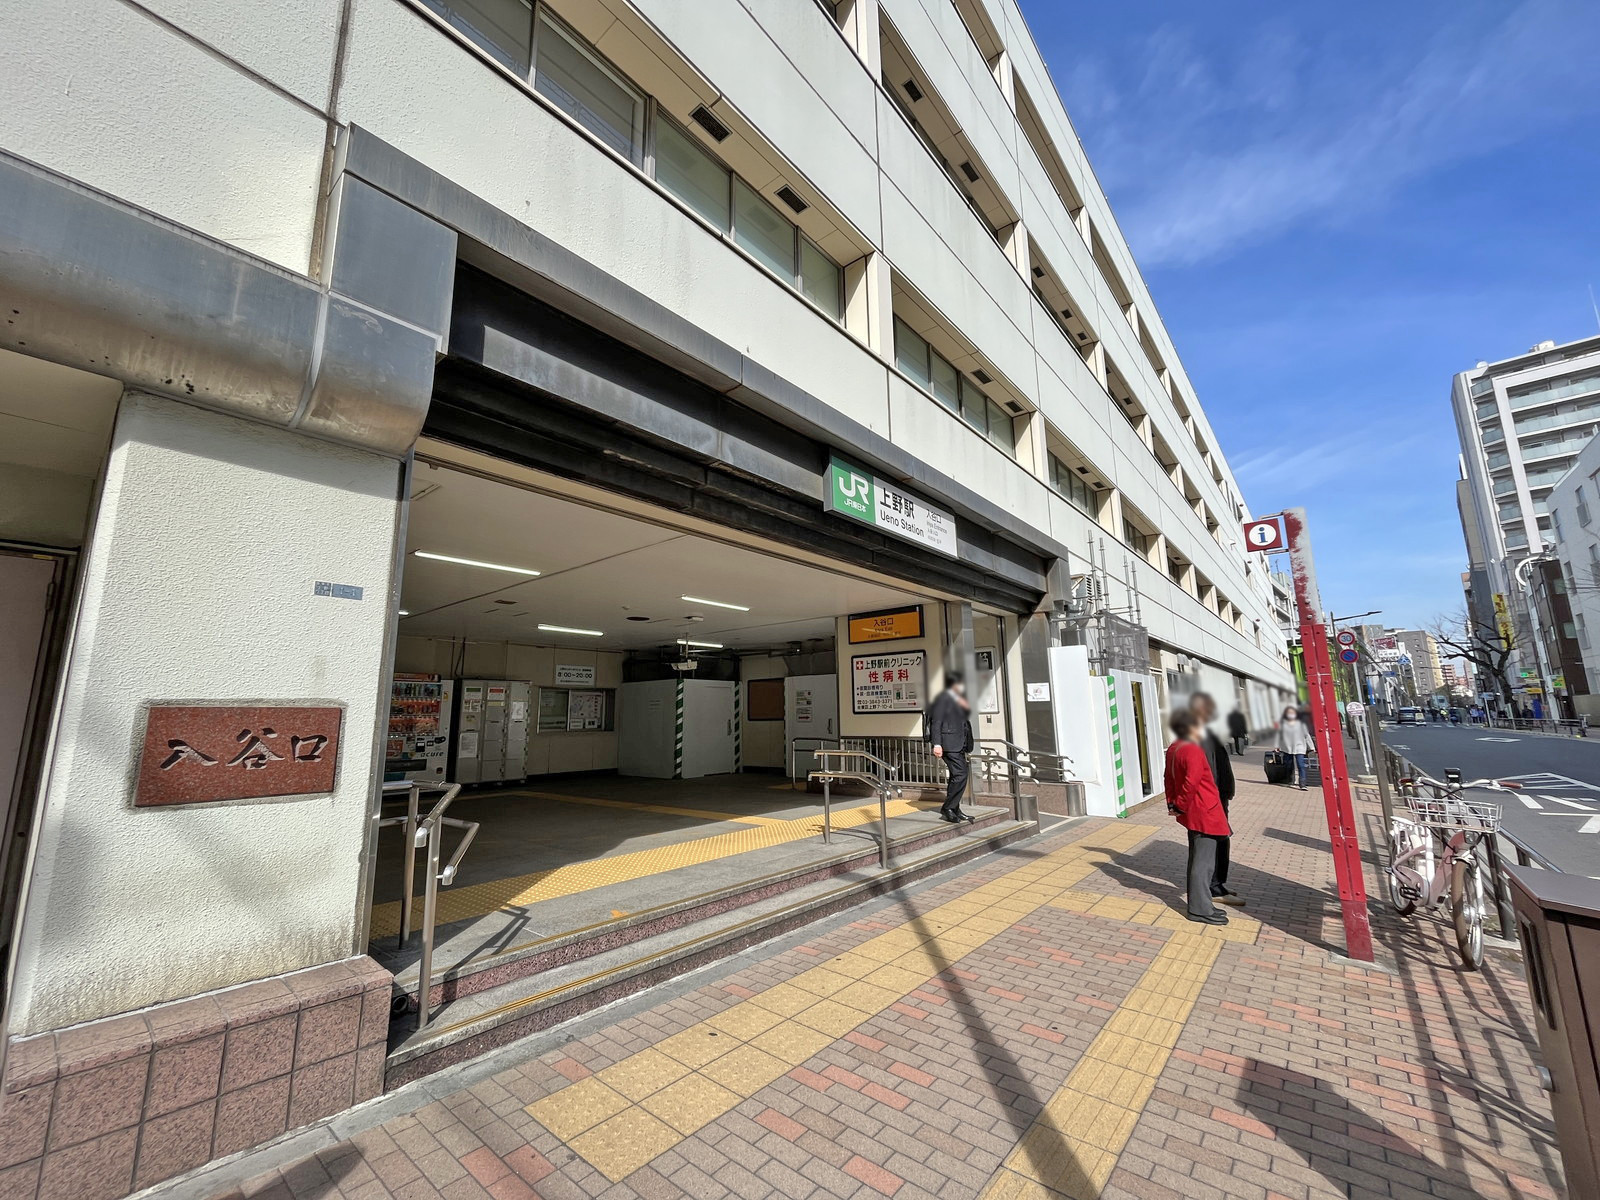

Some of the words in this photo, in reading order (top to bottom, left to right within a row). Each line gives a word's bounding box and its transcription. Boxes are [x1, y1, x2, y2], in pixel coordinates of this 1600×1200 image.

[839, 472, 869, 505] JR
[880, 487, 914, 519] 上野駅
[880, 510, 899, 527] Ueno
[901, 518, 924, 537] Station
[926, 509, 942, 523] 入谷口
[874, 617, 894, 627] 入谷口
[865, 656, 922, 669] 上野駅前クリニック
[869, 669, 909, 683] 性病科
[160, 727, 328, 770] 入谷口
